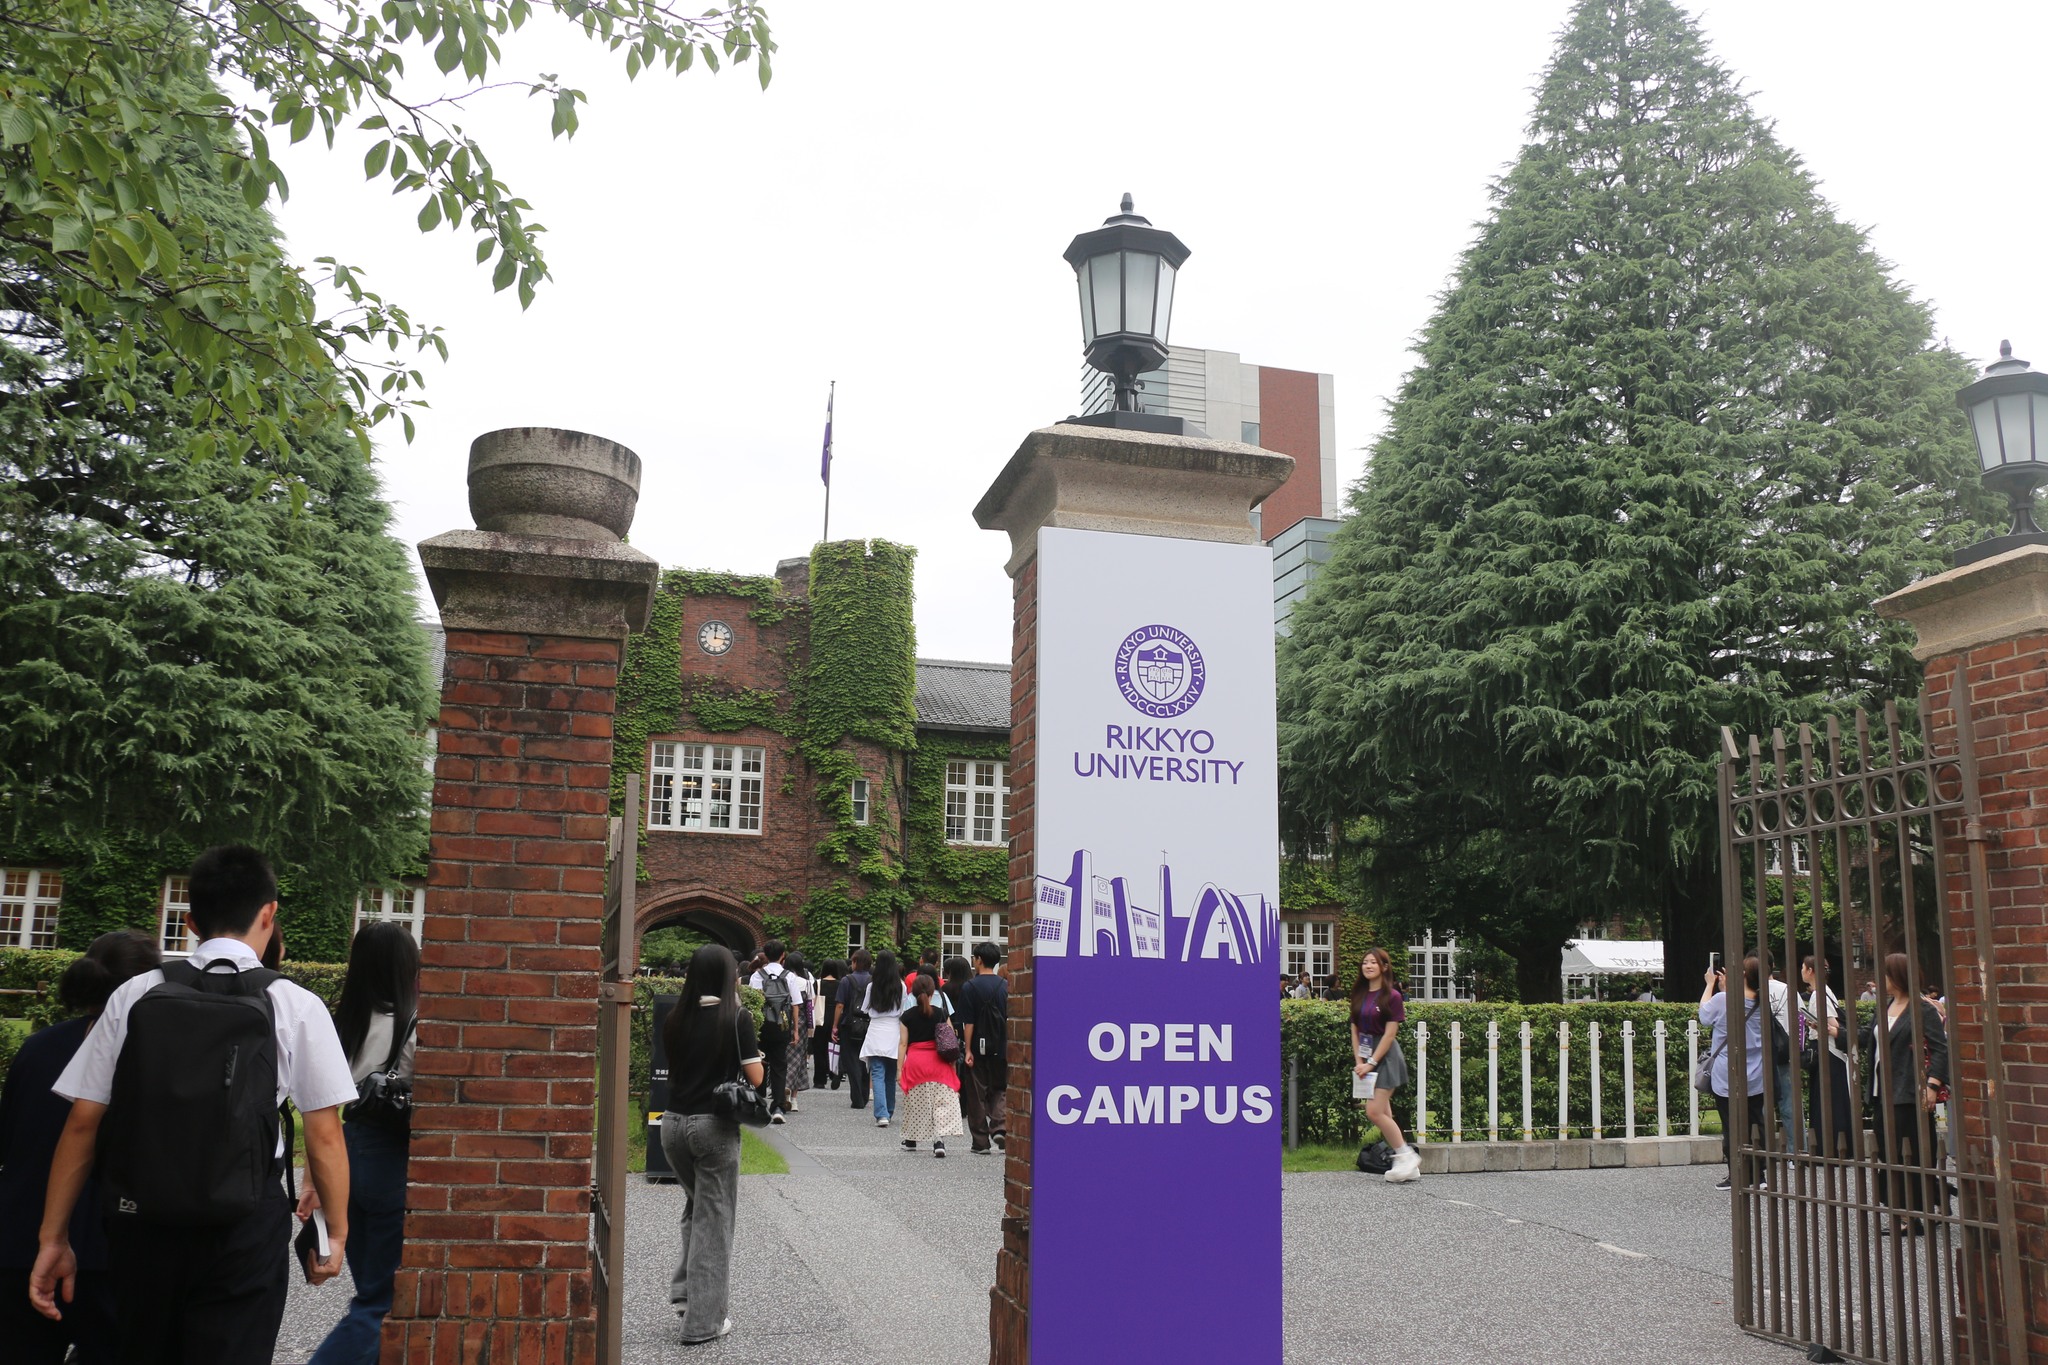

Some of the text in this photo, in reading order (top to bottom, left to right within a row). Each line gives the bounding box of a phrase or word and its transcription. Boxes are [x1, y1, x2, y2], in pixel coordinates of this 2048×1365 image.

[1117, 626, 1204, 681] RIKKYO UNIVERSITY
[1120, 681, 1200, 717] MDCCCLXXIV
[1106, 724, 1215, 755] RIKKYO
[1074, 751, 1245, 785] UNIVERSITY
[1087, 1022, 1233, 1062] OPEN
[1046, 1084, 1274, 1125] CAMPUS
